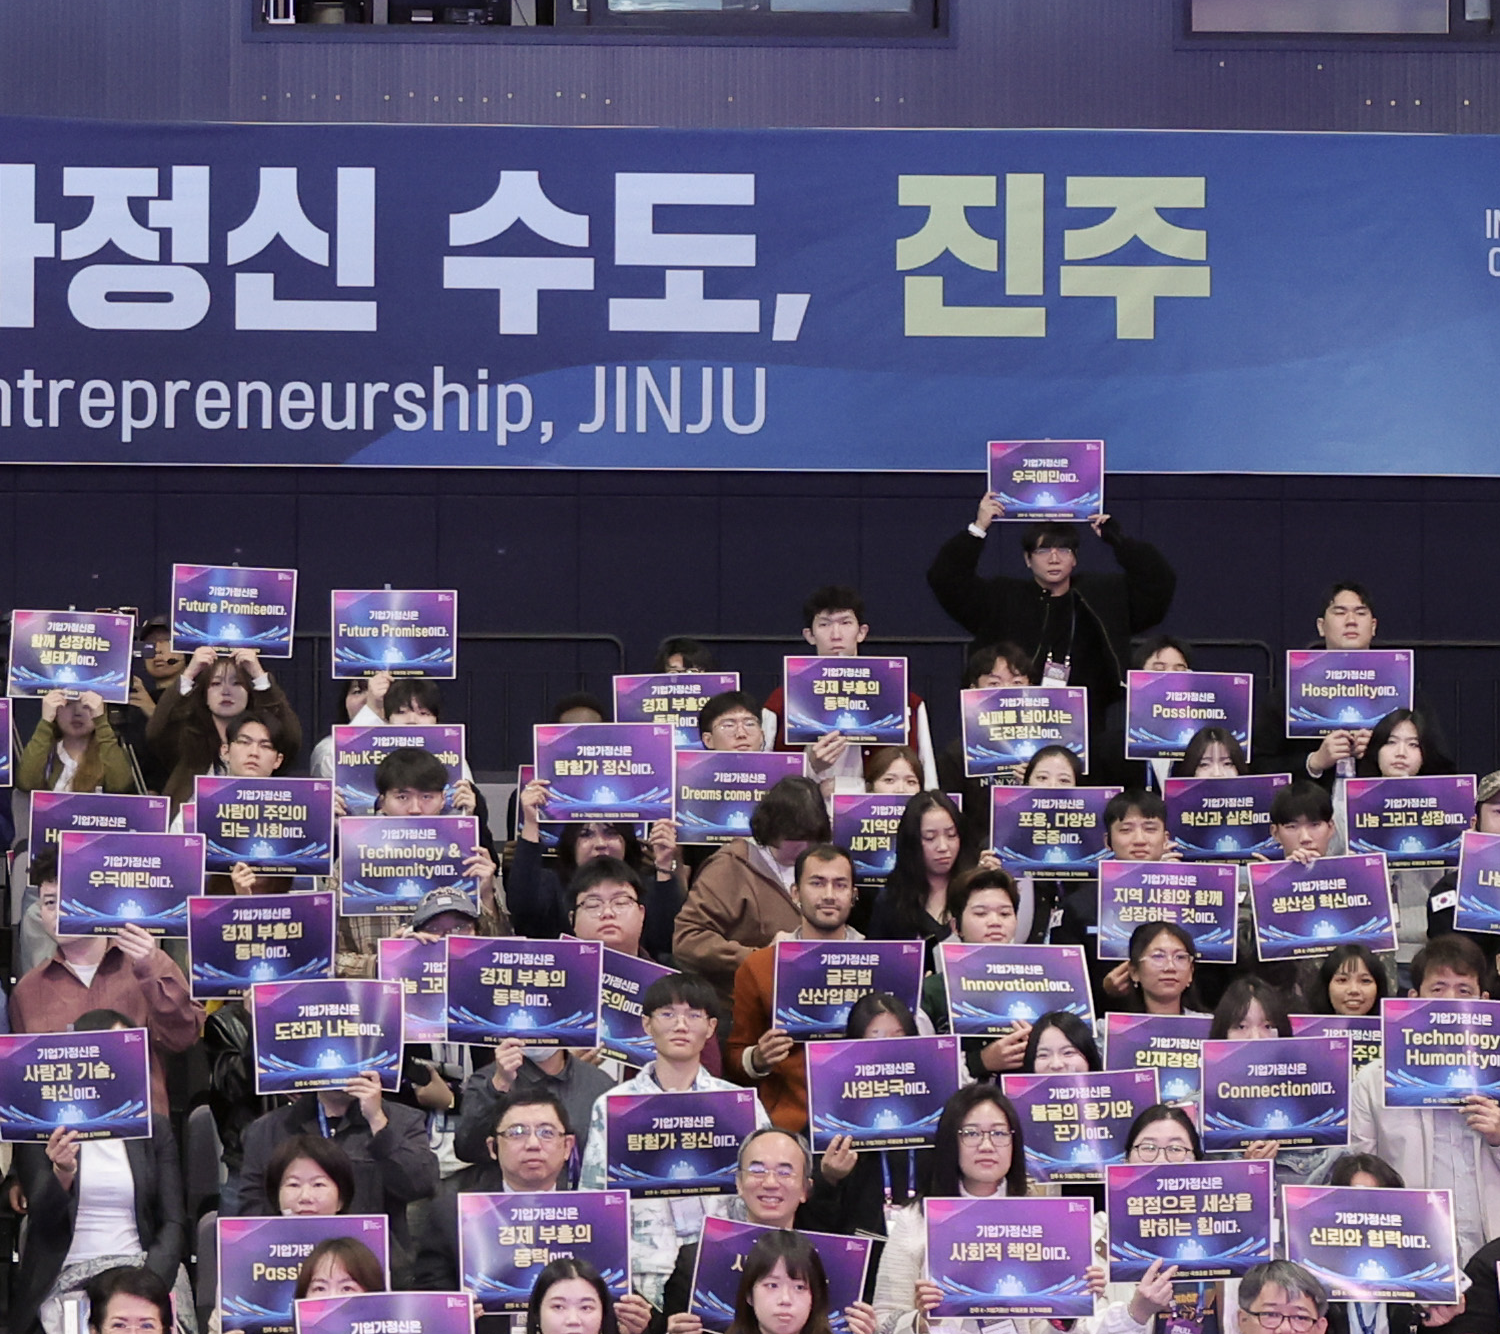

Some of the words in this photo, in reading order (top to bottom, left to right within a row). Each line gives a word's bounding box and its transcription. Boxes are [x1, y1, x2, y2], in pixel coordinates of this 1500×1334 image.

[443, 170, 811, 342] 수도,
[895, 173, 1211, 340] 진주
[578, 365, 766, 435] JINJU
[215, 803, 259, 820] 사람이
[263, 804, 307, 821] 주인이
[220, 821, 250, 838] 되는
[253, 822, 307, 839] 사회이다.
[975, 1224, 1043, 1238] 기업가정신은
[949, 1242, 1002, 1262] 사회적
[1007, 1242, 1071, 1262] 책임이다.
